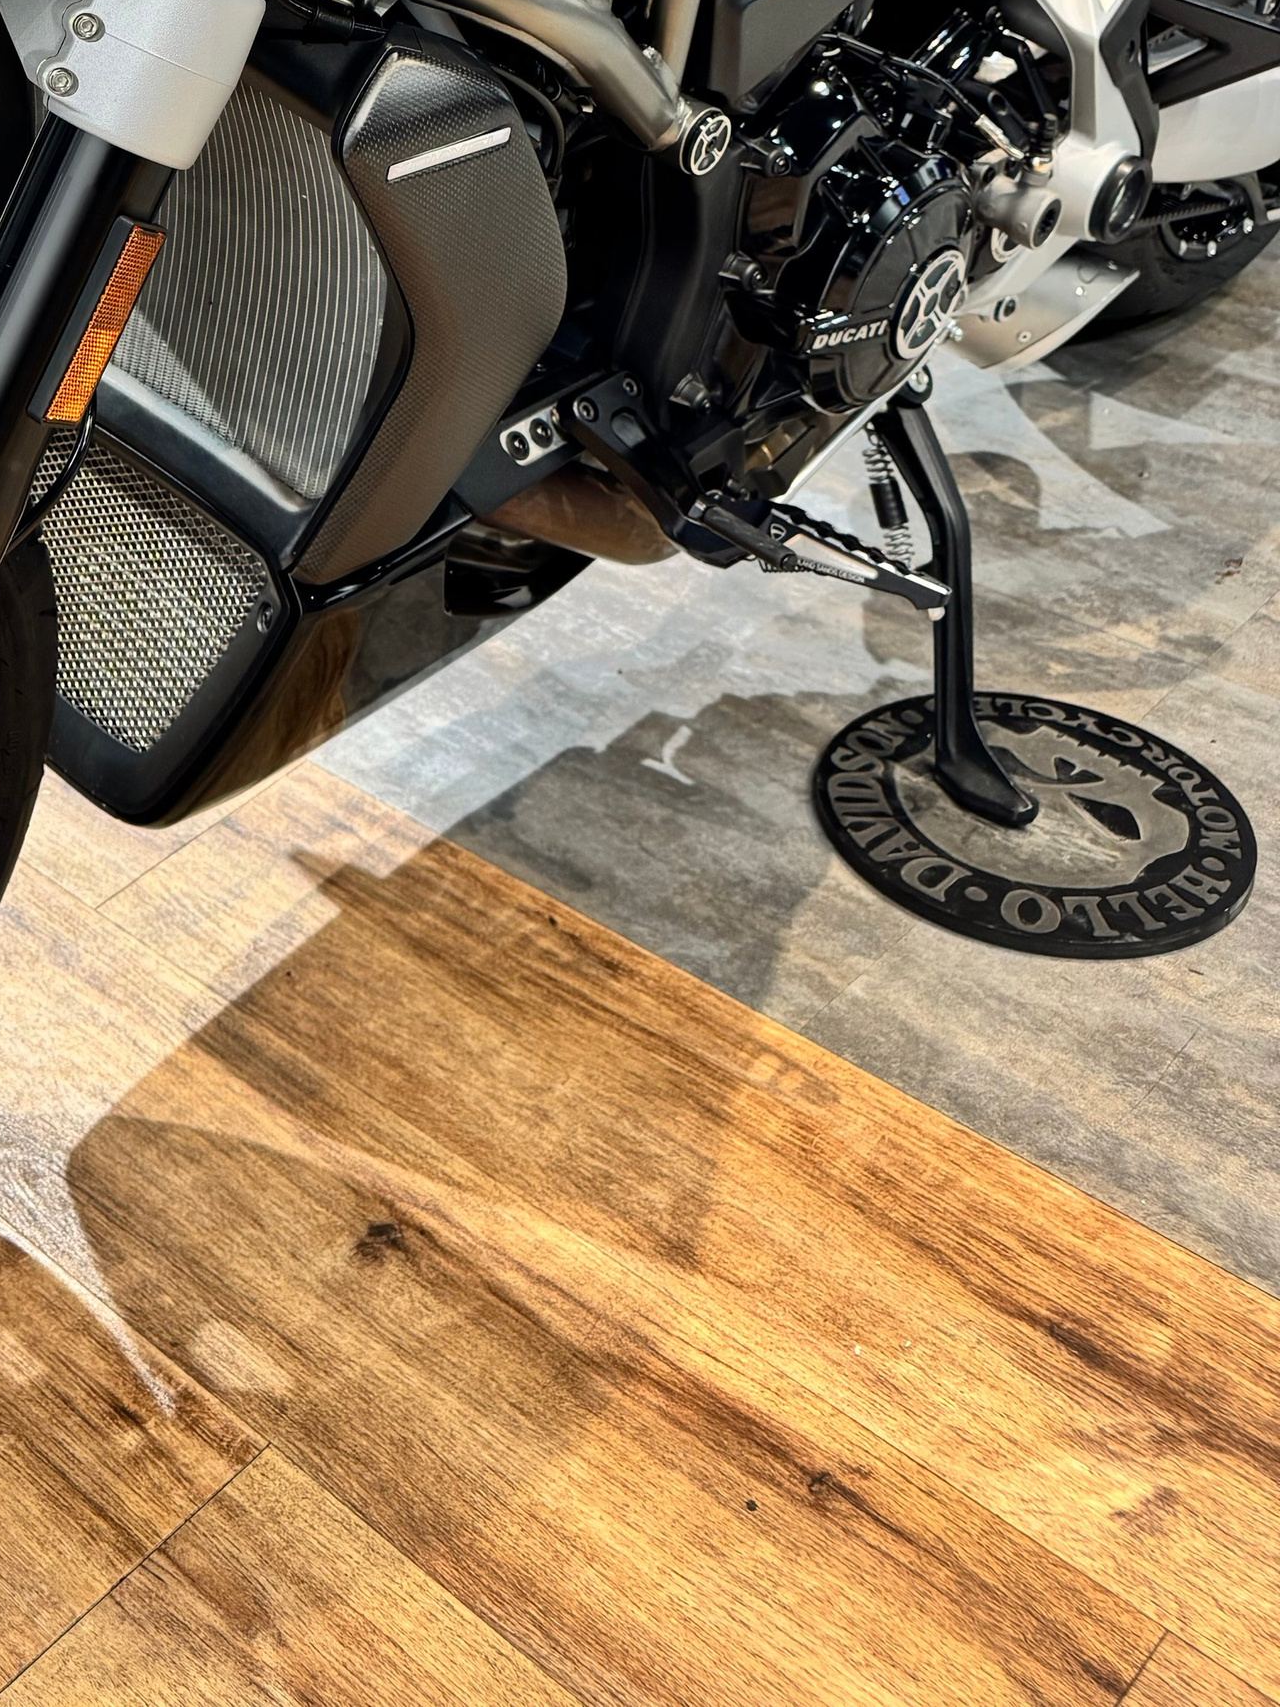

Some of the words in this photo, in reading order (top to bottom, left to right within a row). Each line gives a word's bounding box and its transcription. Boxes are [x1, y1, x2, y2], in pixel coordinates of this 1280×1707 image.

[812, 319, 889, 350] DUCATI
[827, 720, 973, 903] DAVIDSON
[926, 697, 1242, 862] MOTORCYCLE
[1000, 863, 1232, 938] HELLO
